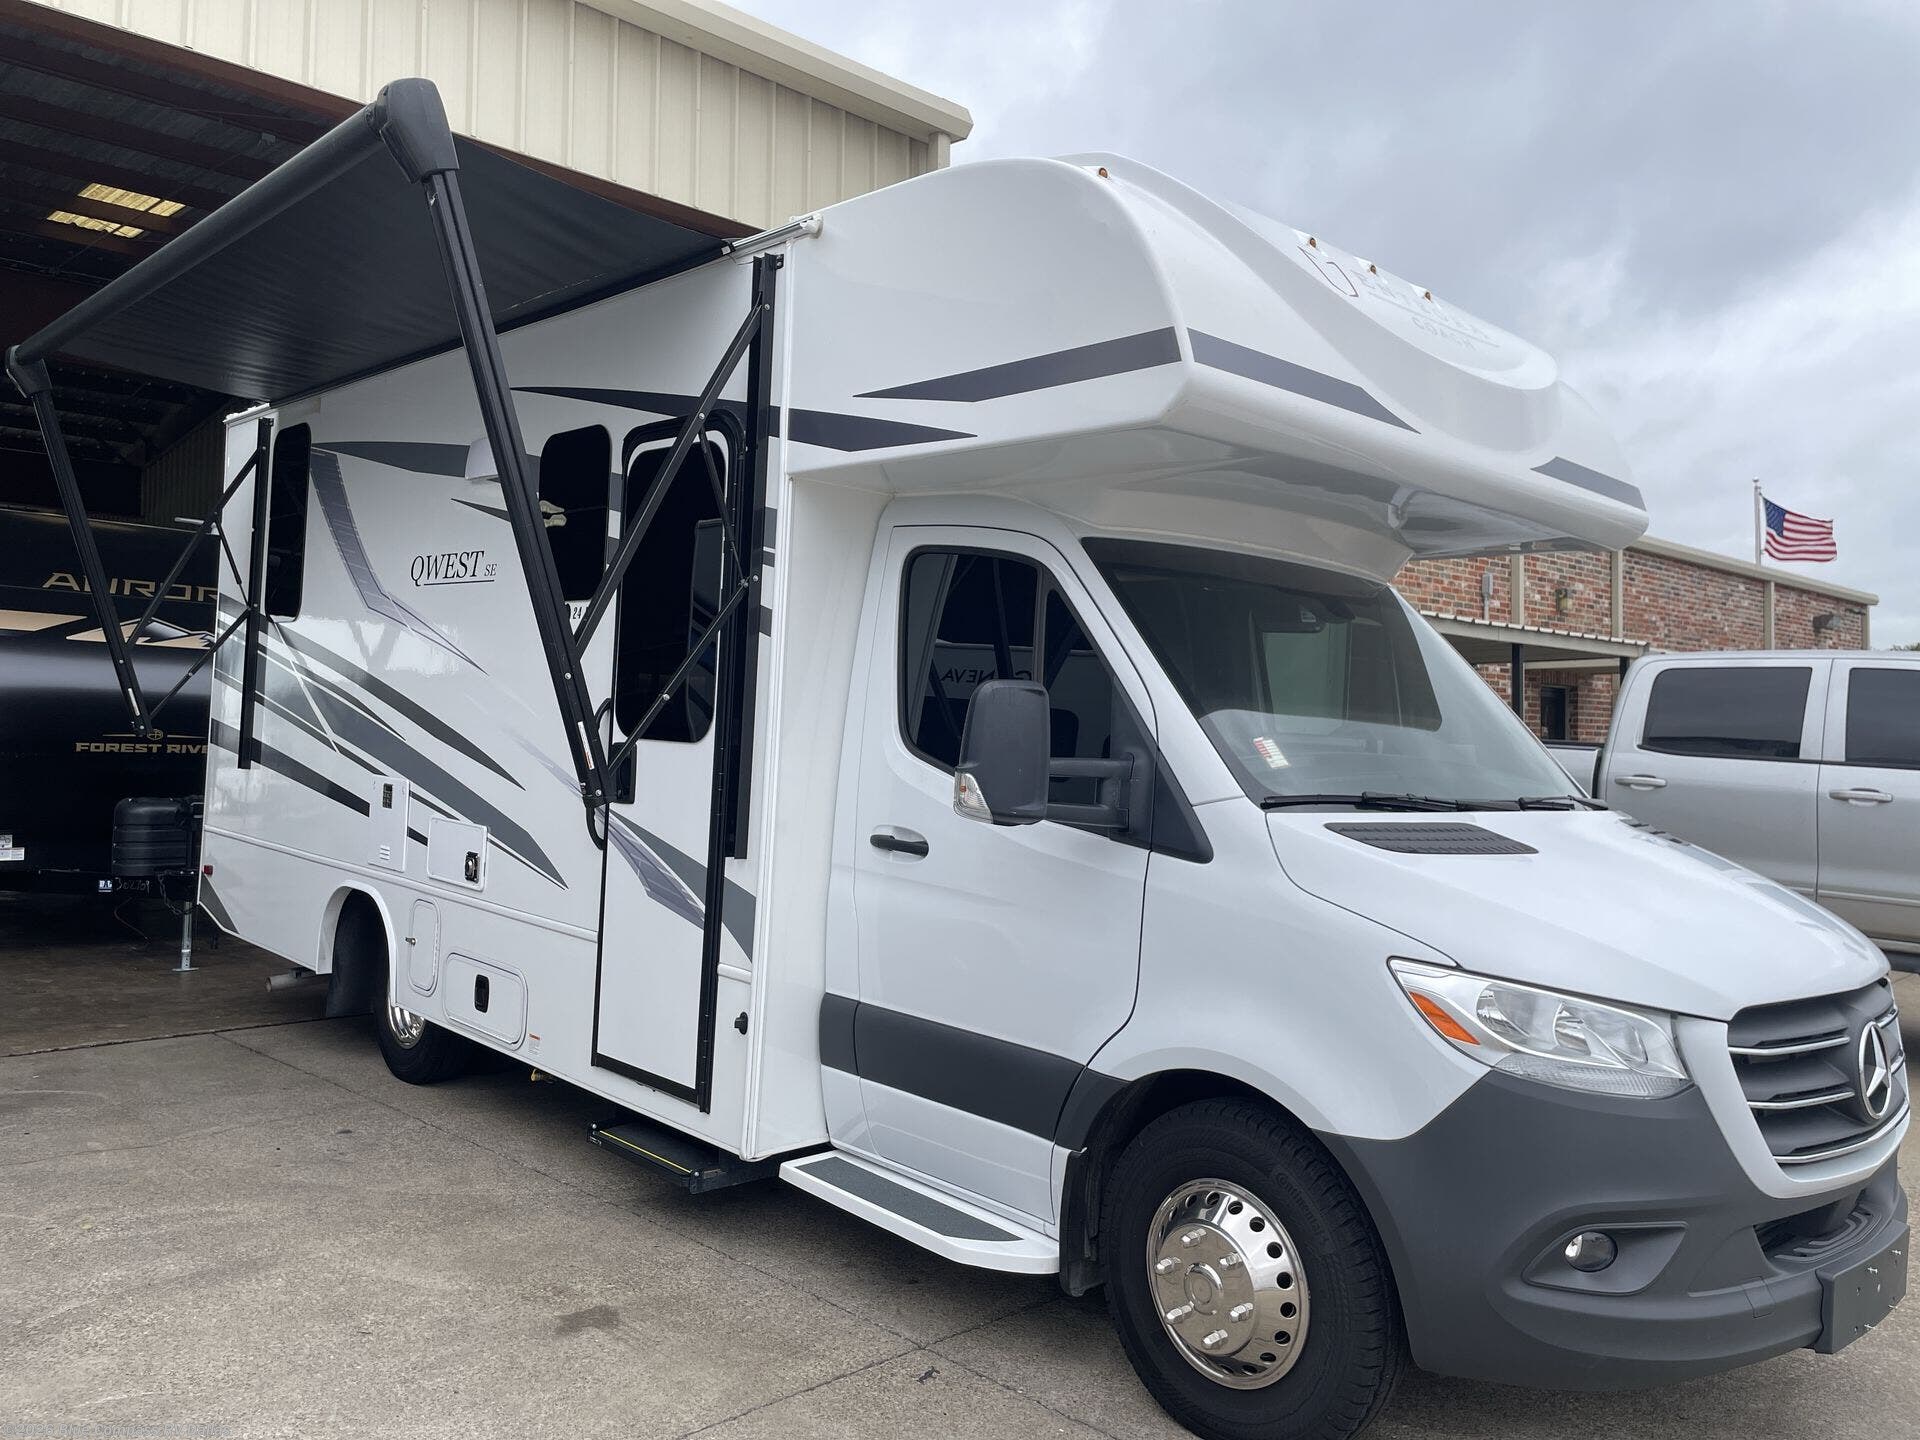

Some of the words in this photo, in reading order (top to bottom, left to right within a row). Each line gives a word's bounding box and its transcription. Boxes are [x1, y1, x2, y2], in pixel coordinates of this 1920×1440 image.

[410, 551, 485, 587] QWEST
[484, 563, 498, 577] SE
[75, 742, 162, 753] FOREST
